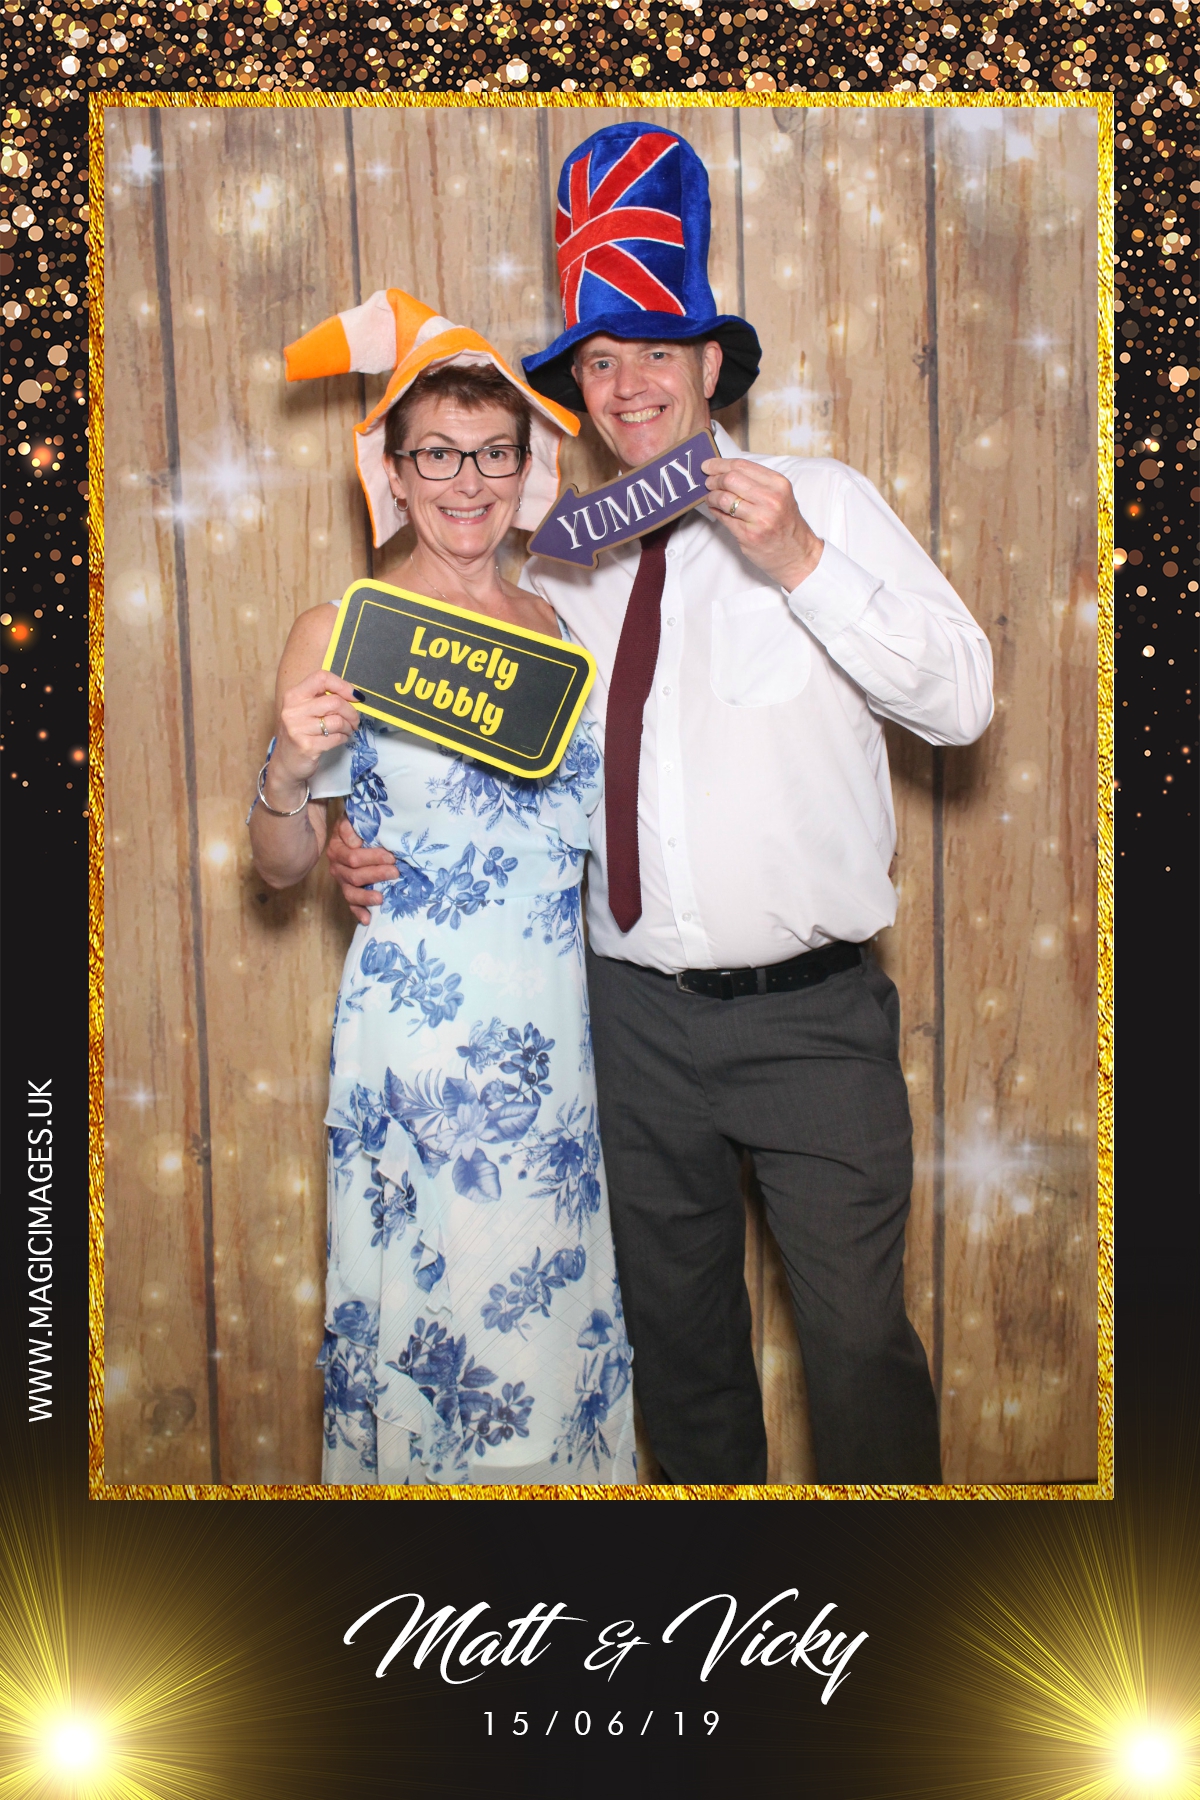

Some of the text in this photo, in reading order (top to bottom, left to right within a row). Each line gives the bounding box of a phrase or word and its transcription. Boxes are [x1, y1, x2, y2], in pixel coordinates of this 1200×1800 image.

[557, 449, 702, 549] YUMMY
[410, 626, 519, 690] Lovely
[394, 667, 504, 736] Jubbly
